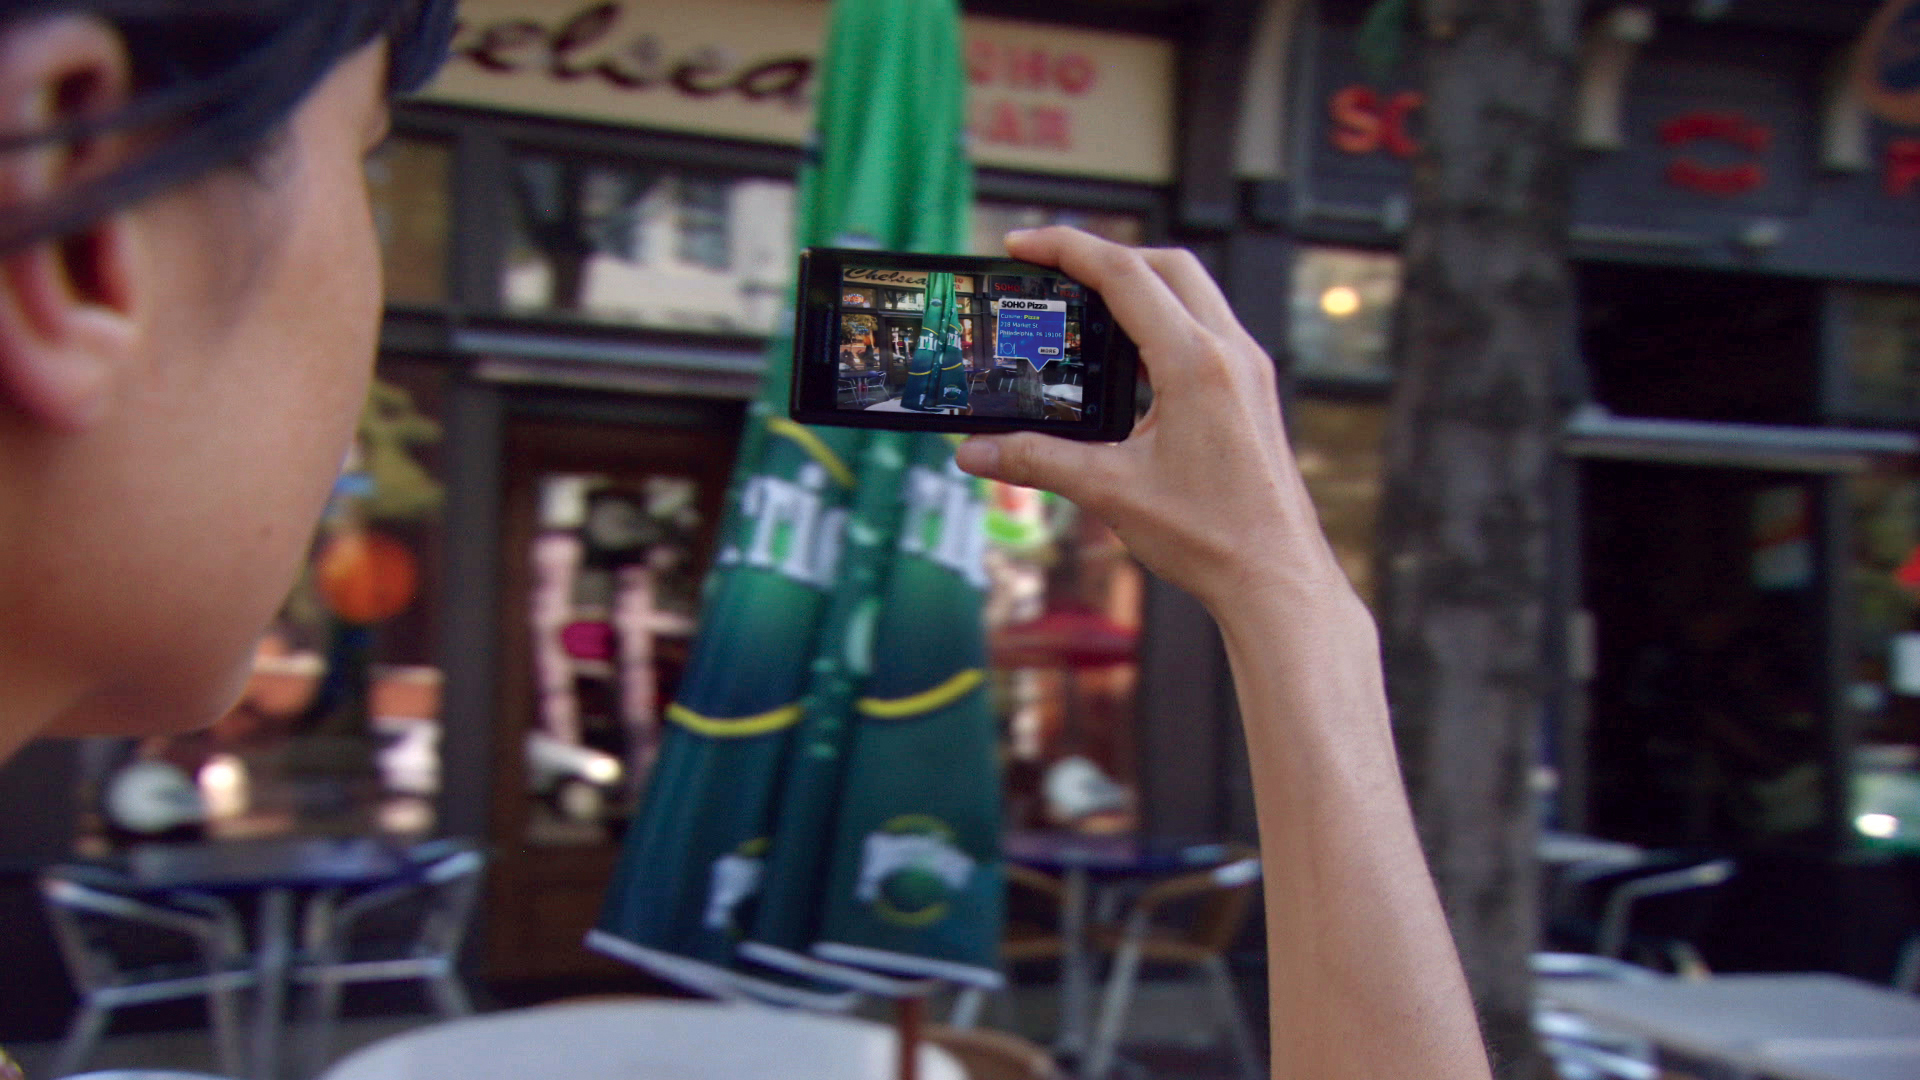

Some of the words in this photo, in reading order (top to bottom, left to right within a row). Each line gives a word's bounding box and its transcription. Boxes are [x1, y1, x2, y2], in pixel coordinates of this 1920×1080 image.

[450, 0, 817, 105] elsea
[967, 40, 1096, 95] OHO
[967, 99, 1074, 151] AR
[845, 268, 927, 285] Chelsea
[994, 282, 1021, 293] SOHO
[1002, 301, 1026, 309] SOHO
[1027, 302, 1048, 310] Pizza
